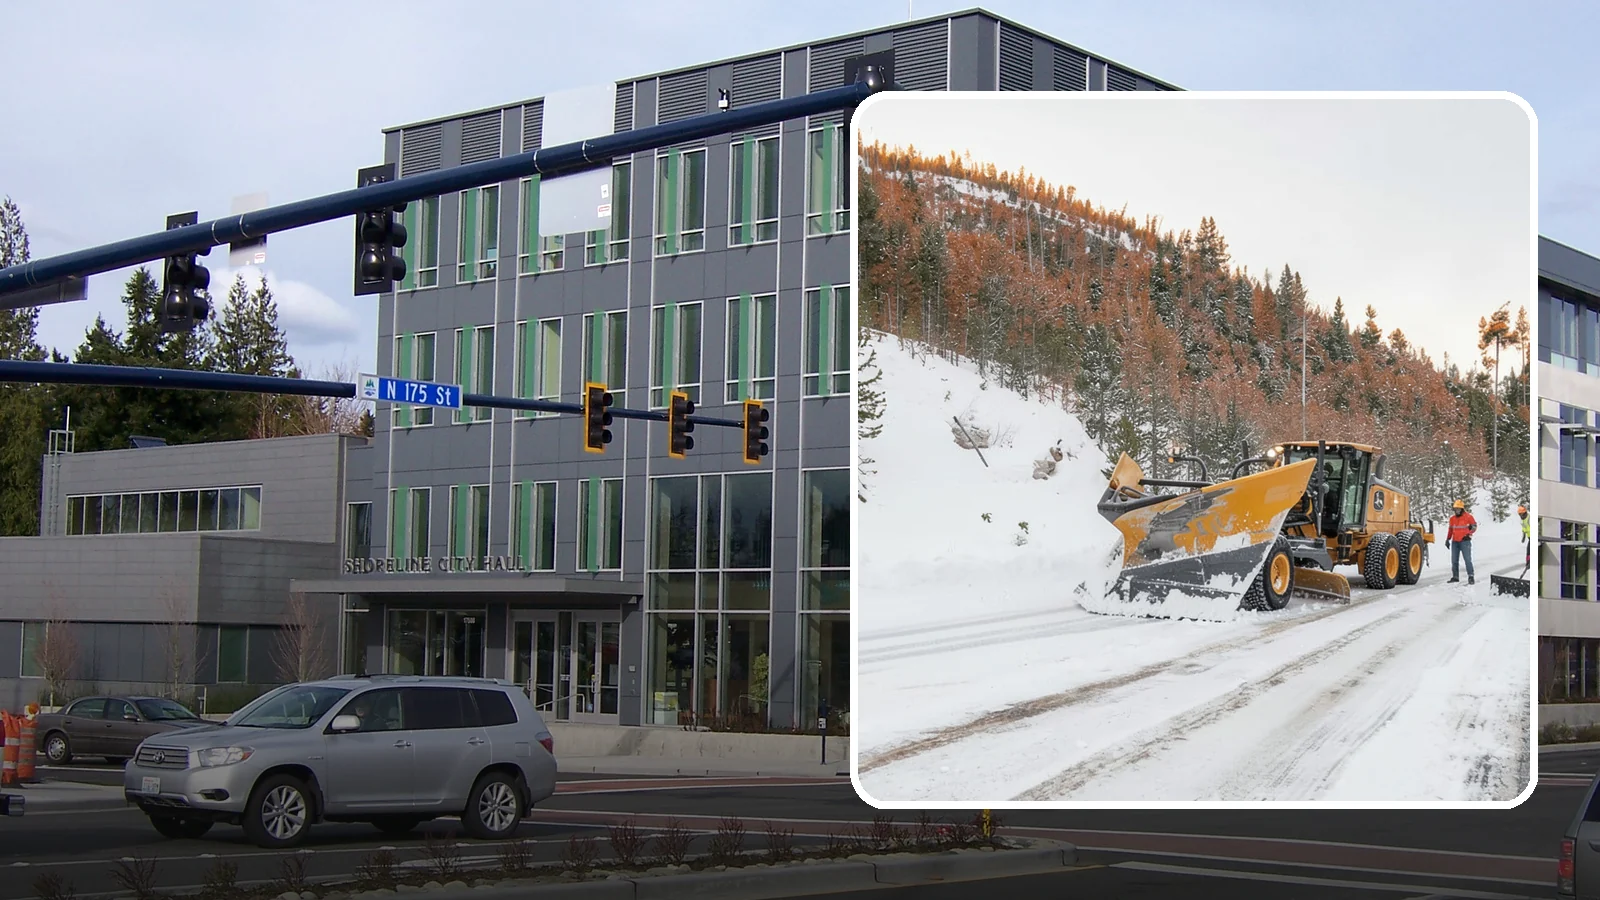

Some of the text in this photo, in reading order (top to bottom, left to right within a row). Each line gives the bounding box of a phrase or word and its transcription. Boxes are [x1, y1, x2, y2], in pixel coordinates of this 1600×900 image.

[387, 380, 451, 406] N 175 St
[344, 555, 526, 574] SHORELINE CITY HALL
